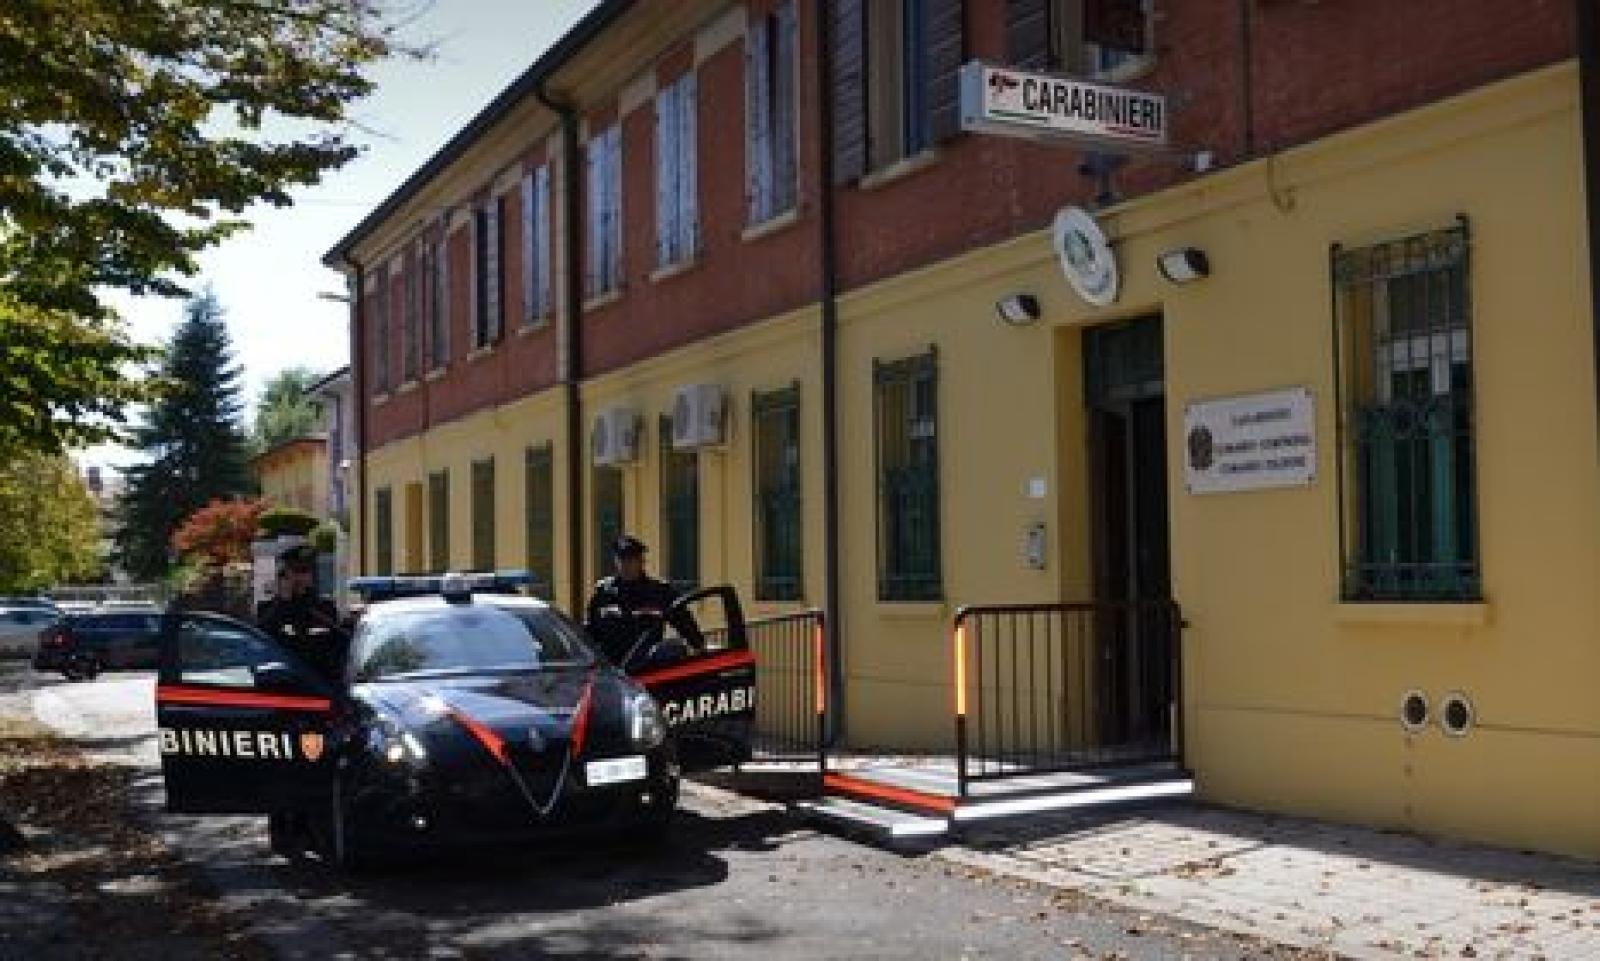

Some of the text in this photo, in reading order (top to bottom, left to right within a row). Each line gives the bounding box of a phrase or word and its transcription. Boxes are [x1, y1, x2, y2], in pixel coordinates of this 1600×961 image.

[1022, 78, 1163, 131] CARABINIERI
[662, 686, 755, 725] CARABI
[159, 727, 294, 760] BINIERI
